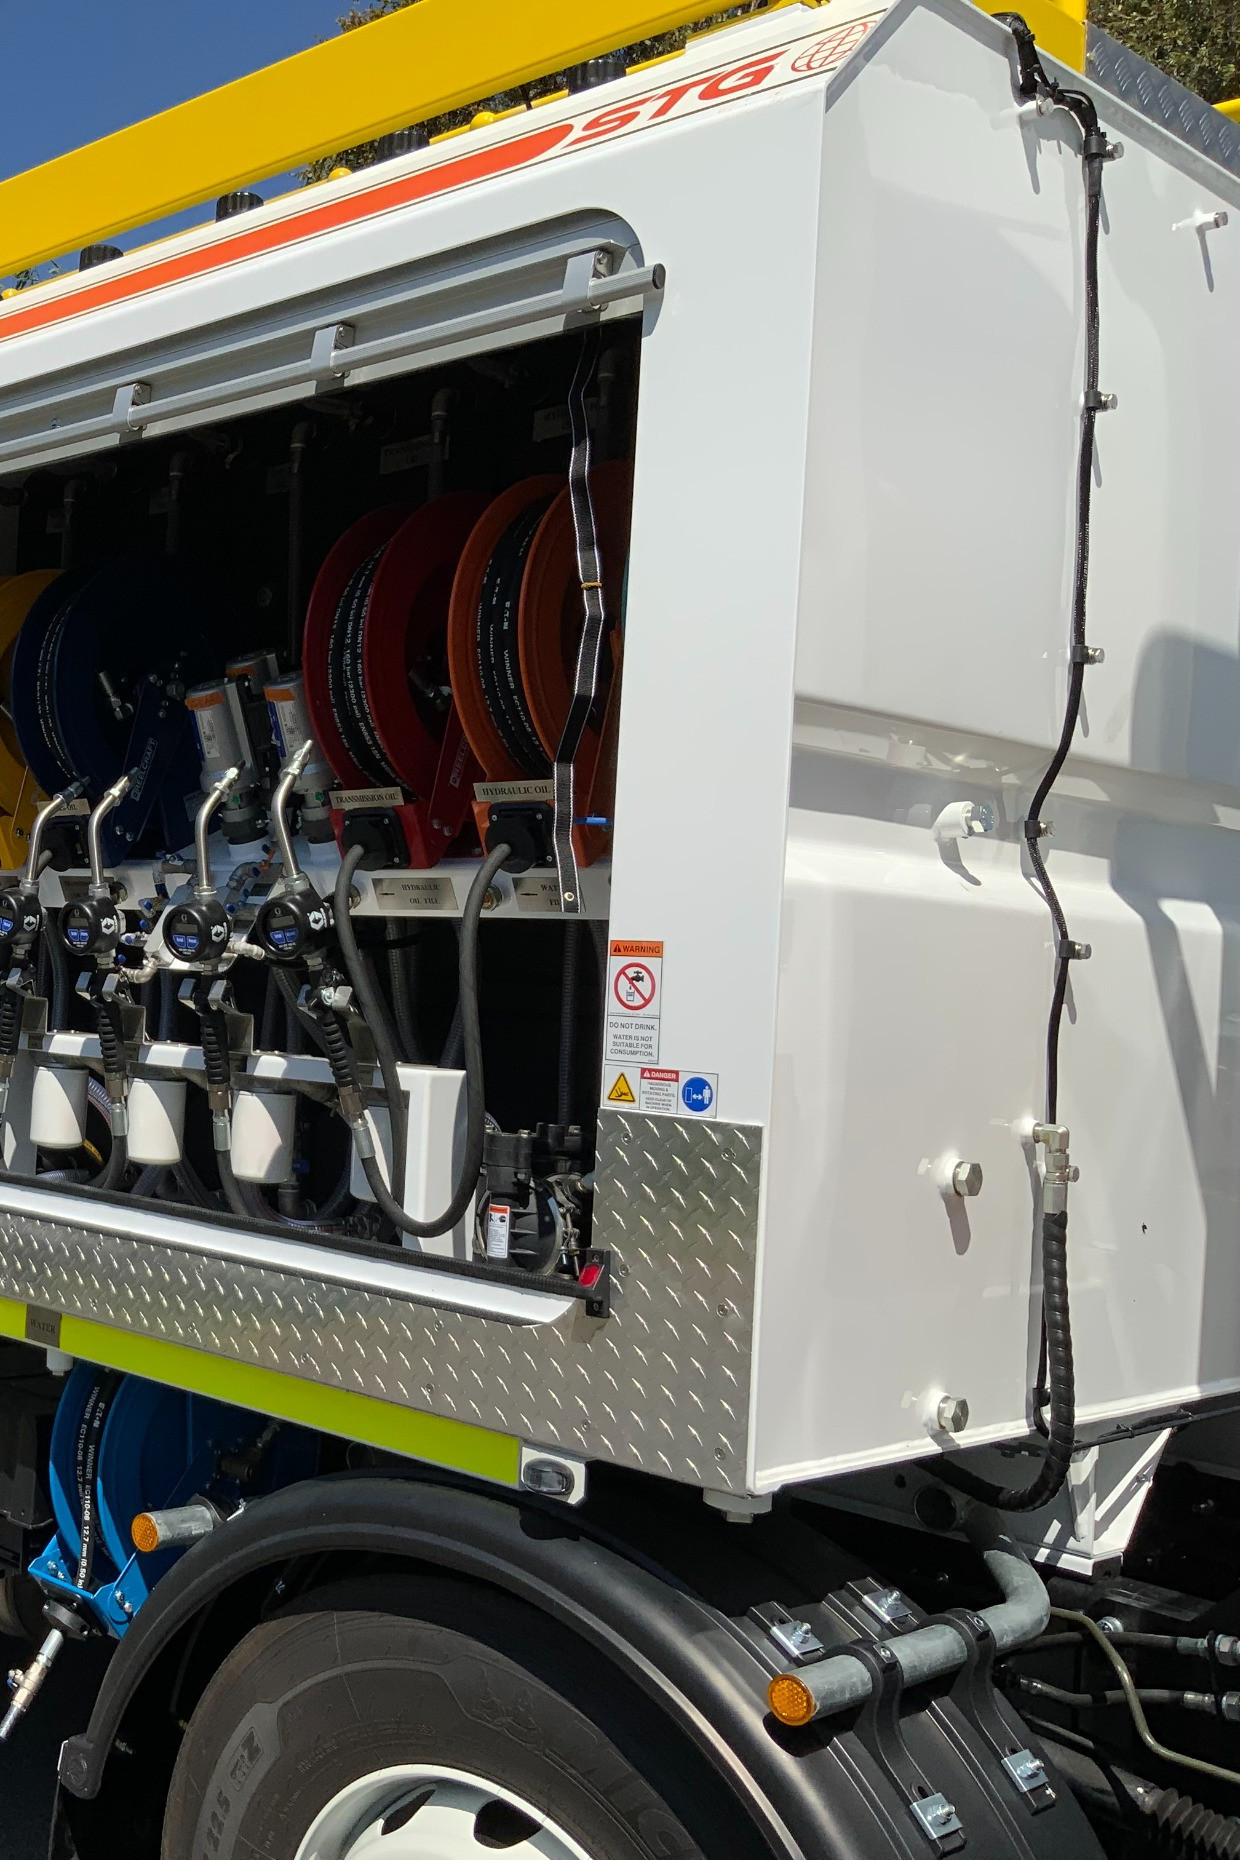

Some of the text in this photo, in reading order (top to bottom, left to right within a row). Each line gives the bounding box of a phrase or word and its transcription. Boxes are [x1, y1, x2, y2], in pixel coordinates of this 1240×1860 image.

[560, 48, 791, 150] STG
[344, 621, 352, 644] DN12
[503, 649, 515, 690] WINNER
[482, 785, 551, 796] HYDRAULIC OIL
[335, 793, 398, 804] TRANSMISSION OIL
[540, 884, 558, 892] WAT
[409, 897, 420, 905] OIL
[622, 945, 661, 954] WARNING
[609, 1021, 657, 1031] DO NOT DRINK.
[612, 1033, 633, 1041] WATER
[612, 1041, 640, 1049] SUITABLE
[610, 1048, 655, 1058] CONSUMPTION.
[651, 1071, 677, 1080] DANGER
[30, 1318, 56, 1335] WATER
[84, 1386, 101, 1420] WINNER
[85, 1444, 96, 1480] WINNER
[83, 1484, 92, 1521] EC110-08
[81, 1543, 88, 1557] mm
[79, 1558, 88, 1578] (0.50
